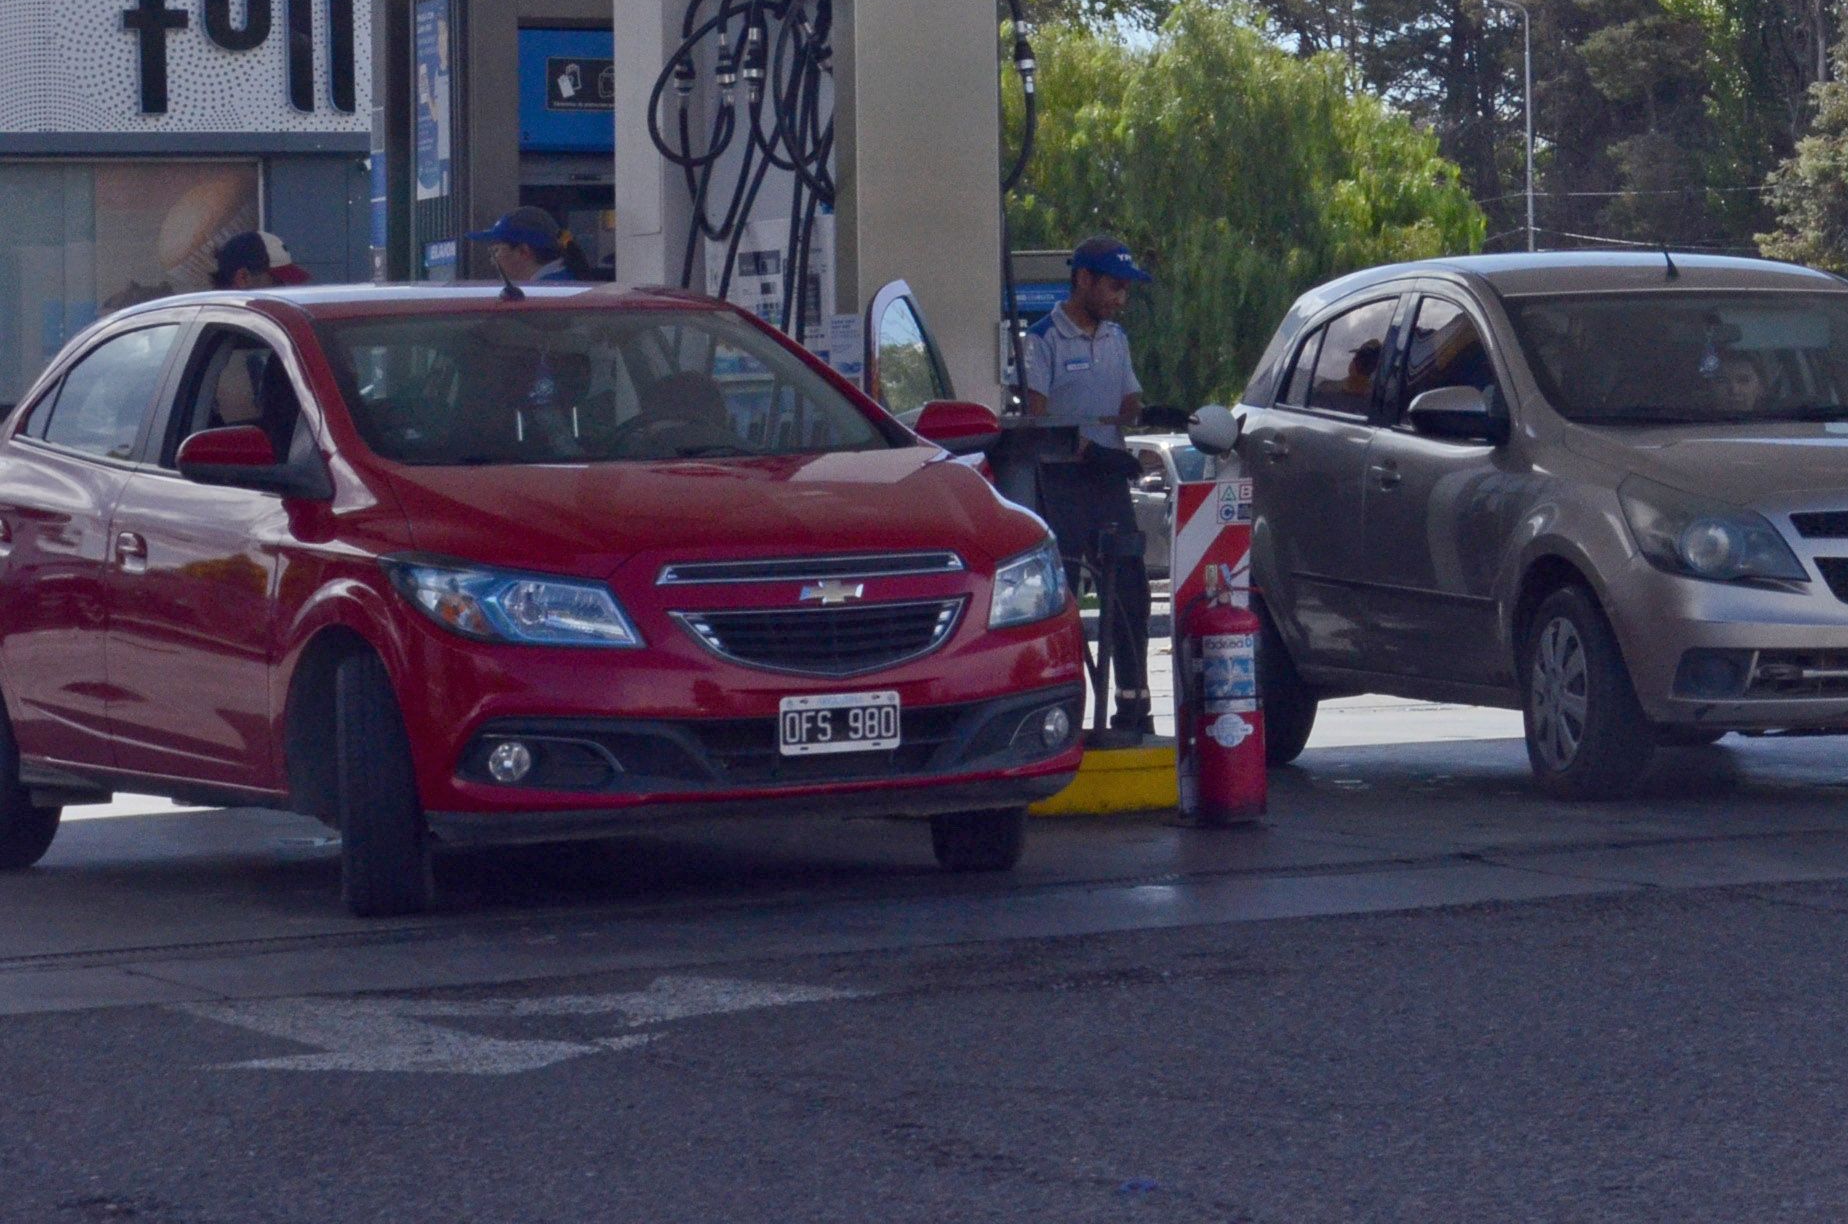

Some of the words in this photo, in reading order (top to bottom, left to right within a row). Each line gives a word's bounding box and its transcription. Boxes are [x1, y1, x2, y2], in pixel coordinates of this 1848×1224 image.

[1241, 485, 1253, 499] B
[1222, 506, 1234, 520] C
[785, 709, 832, 744] OFS
[848, 706, 895, 739] 980
